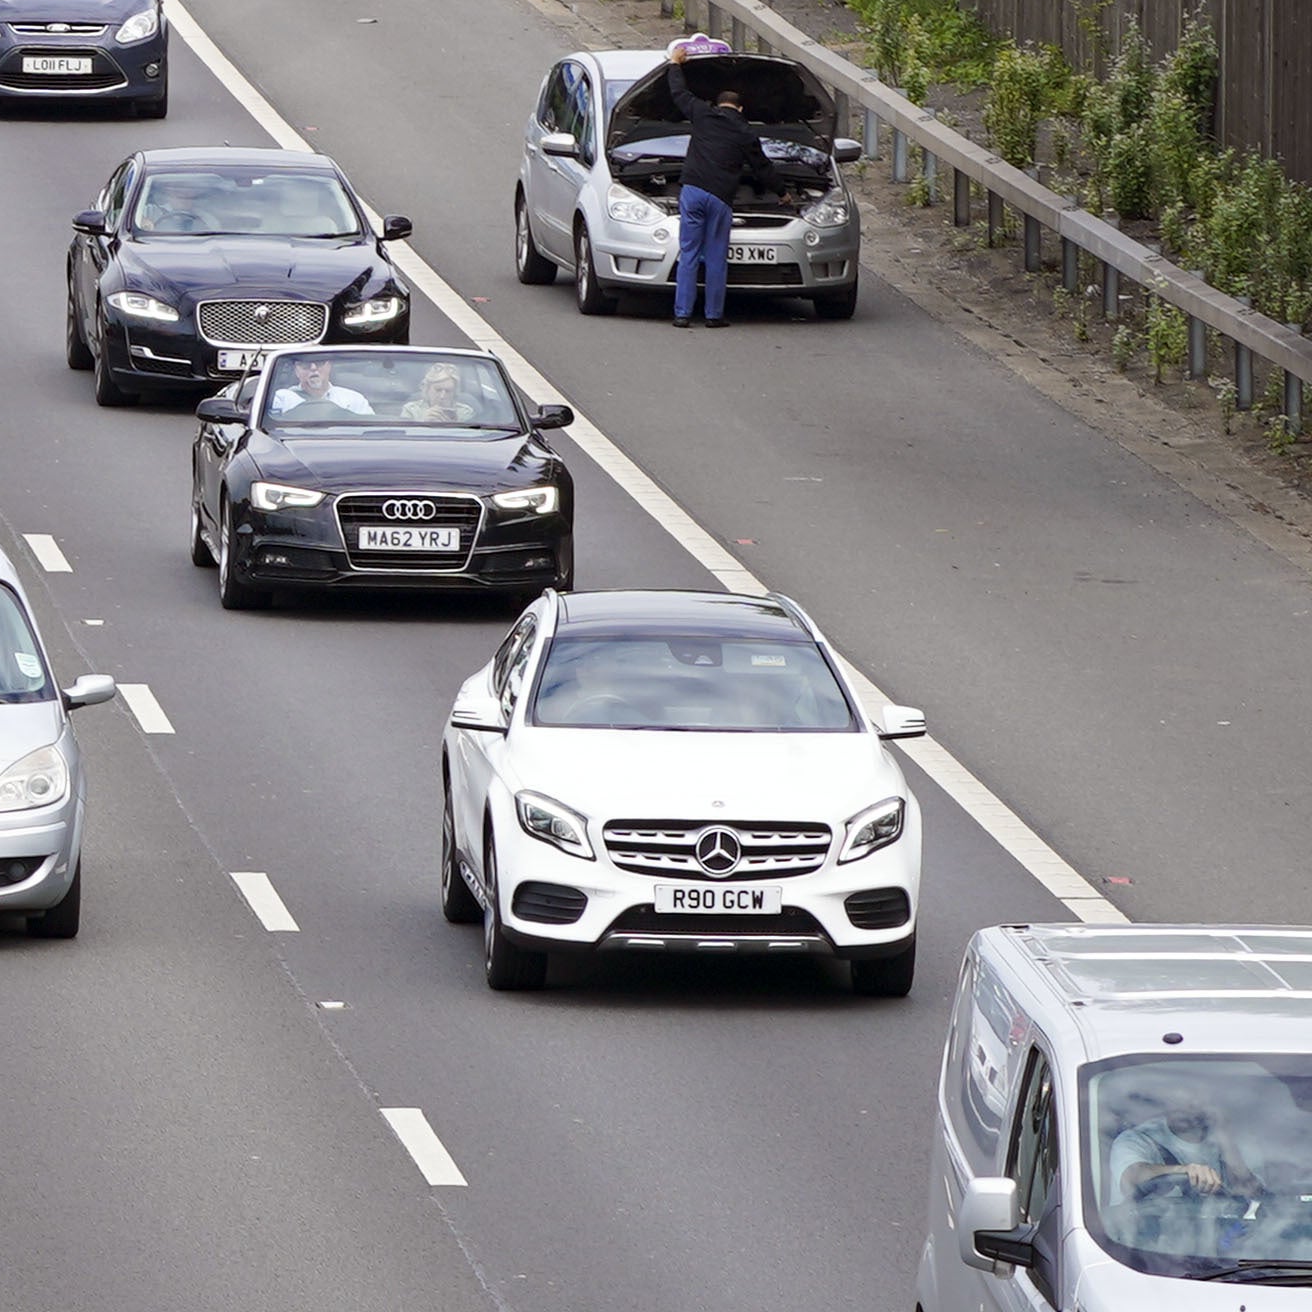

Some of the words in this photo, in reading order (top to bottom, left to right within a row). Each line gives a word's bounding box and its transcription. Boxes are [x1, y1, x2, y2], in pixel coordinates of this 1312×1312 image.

[58, 60, 81, 71] FLJ
[748, 247, 775, 261] XWG
[368, 531, 412, 547] MA62
[419, 531, 451, 547] YRJ
[674, 889, 715, 908] R90
[723, 890, 763, 909] GCW
